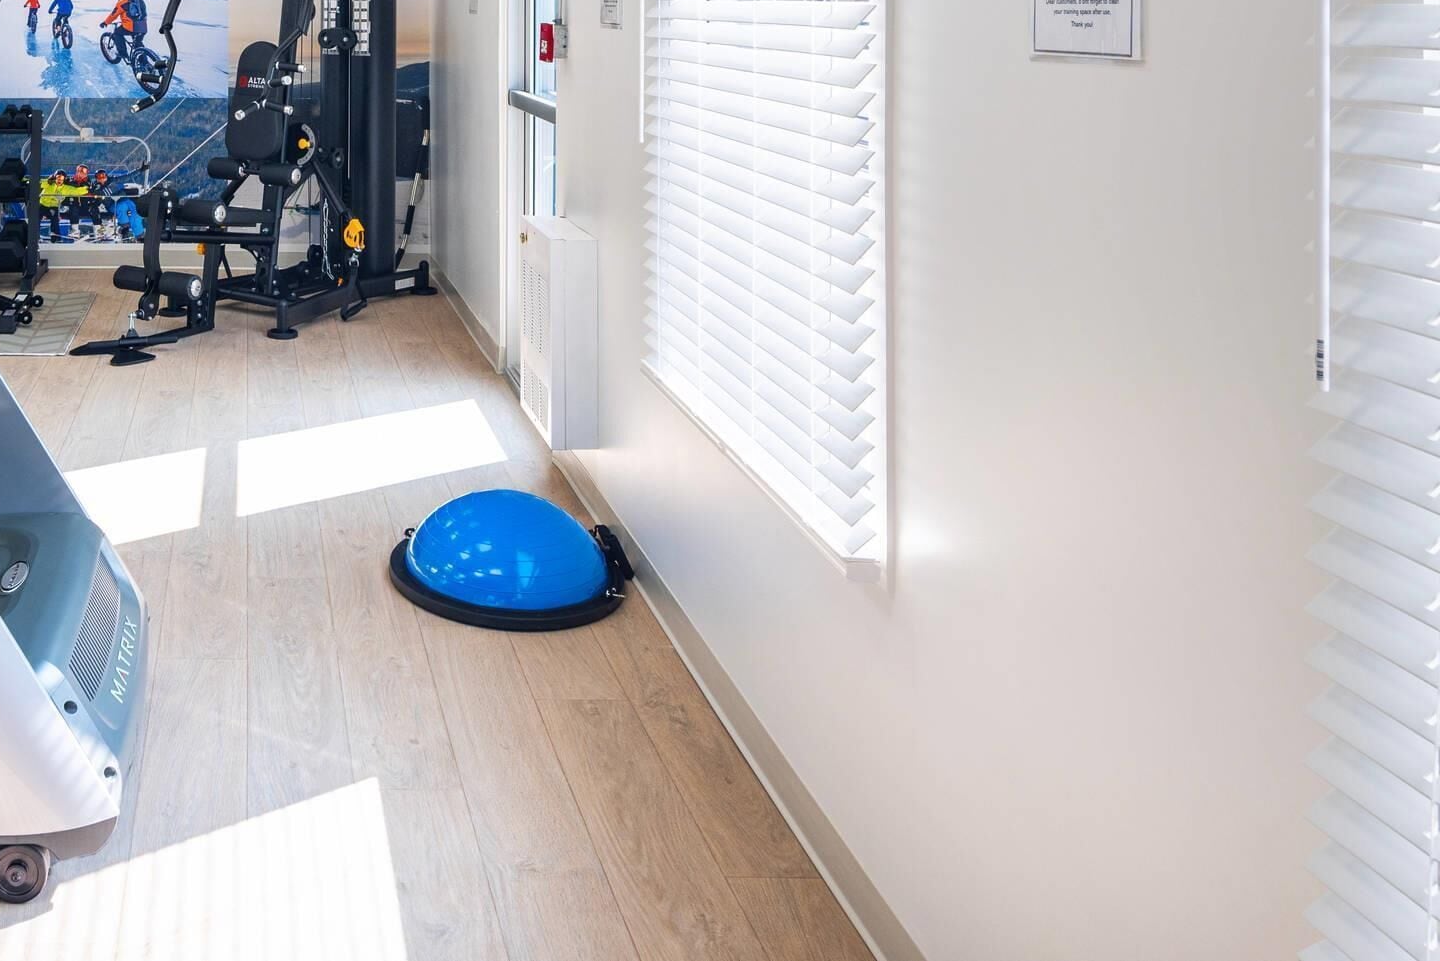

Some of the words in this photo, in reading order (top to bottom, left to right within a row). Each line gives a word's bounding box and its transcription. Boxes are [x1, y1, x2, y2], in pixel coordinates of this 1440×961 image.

[1064, 9, 1079, 17] training
[1071, 20, 1083, 28] Thank
[248, 76, 266, 85] ALTA
[110, 615, 138, 704] MATRIX
